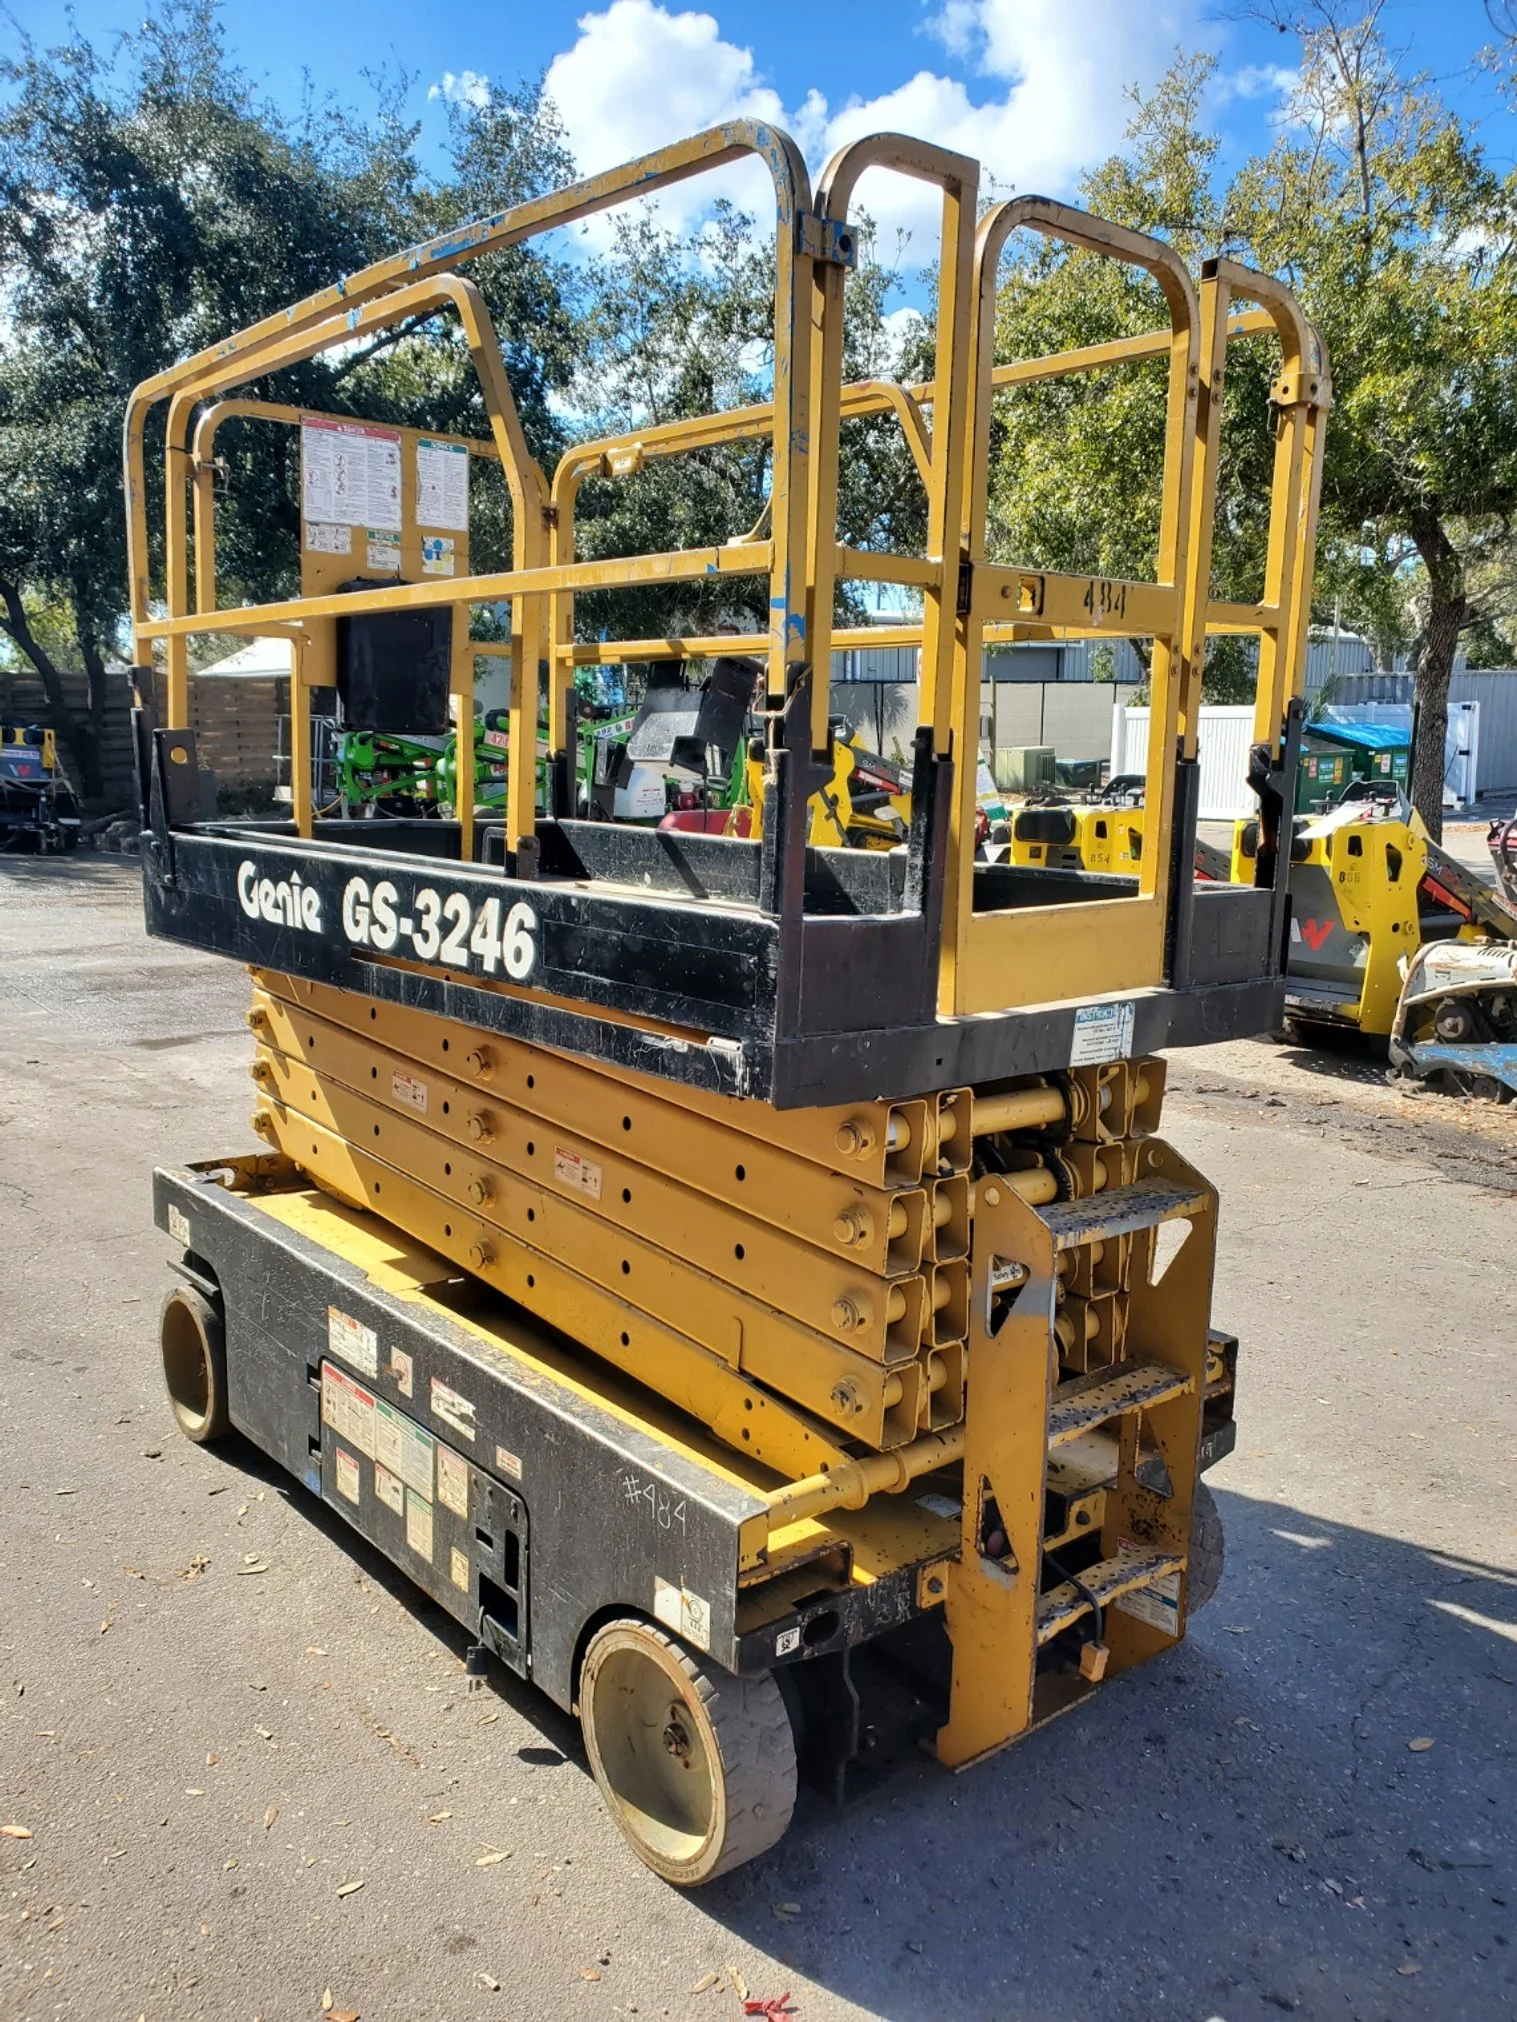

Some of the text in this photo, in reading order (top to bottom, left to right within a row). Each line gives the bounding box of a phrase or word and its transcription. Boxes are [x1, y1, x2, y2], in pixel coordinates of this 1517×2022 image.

[1083, 580, 1127, 620] 484
[237, 860, 537, 980] Genie GS-3246
